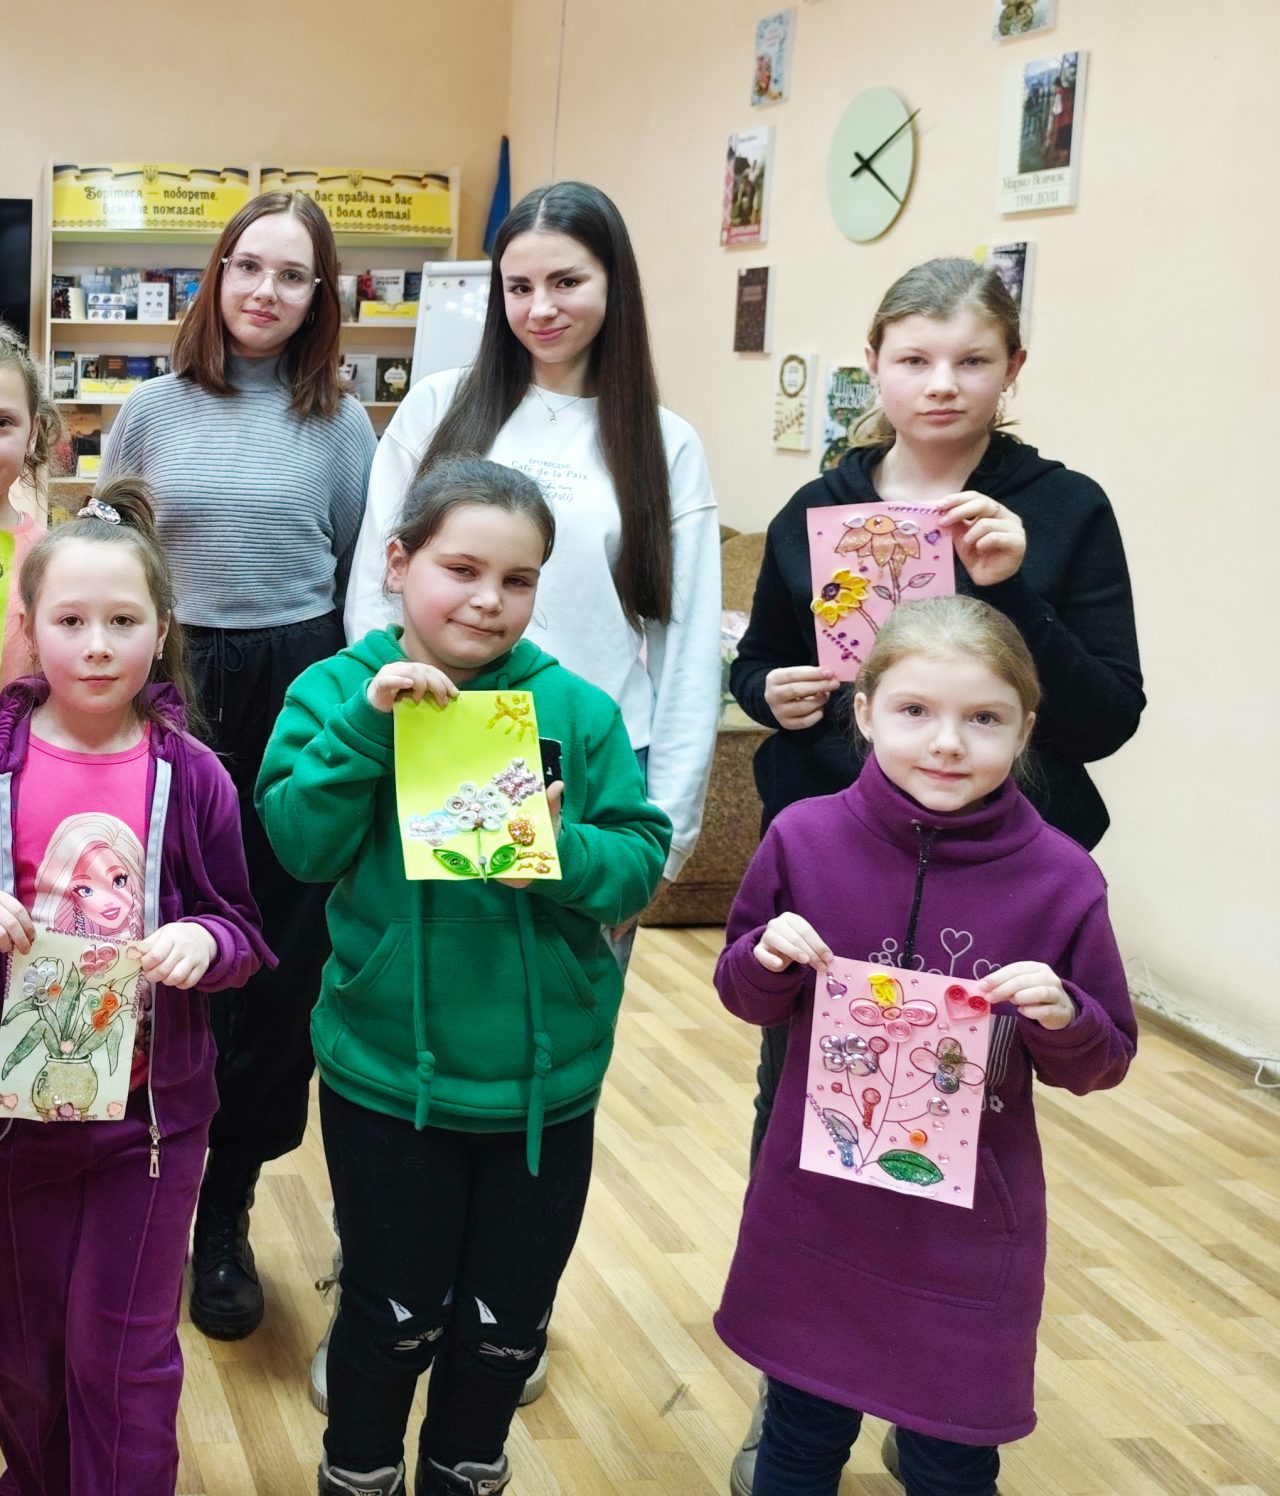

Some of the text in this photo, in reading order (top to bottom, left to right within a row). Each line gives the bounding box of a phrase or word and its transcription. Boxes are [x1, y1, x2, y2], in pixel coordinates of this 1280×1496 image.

[314, 190, 333, 201] вас
[338, 191, 375, 205] правда
[379, 195, 391, 204] за
[394, 193, 413, 205] вас
[153, 204, 205, 216] помагає!
[336, 206, 363, 218] воля
[367, 208, 411, 220] святая!
